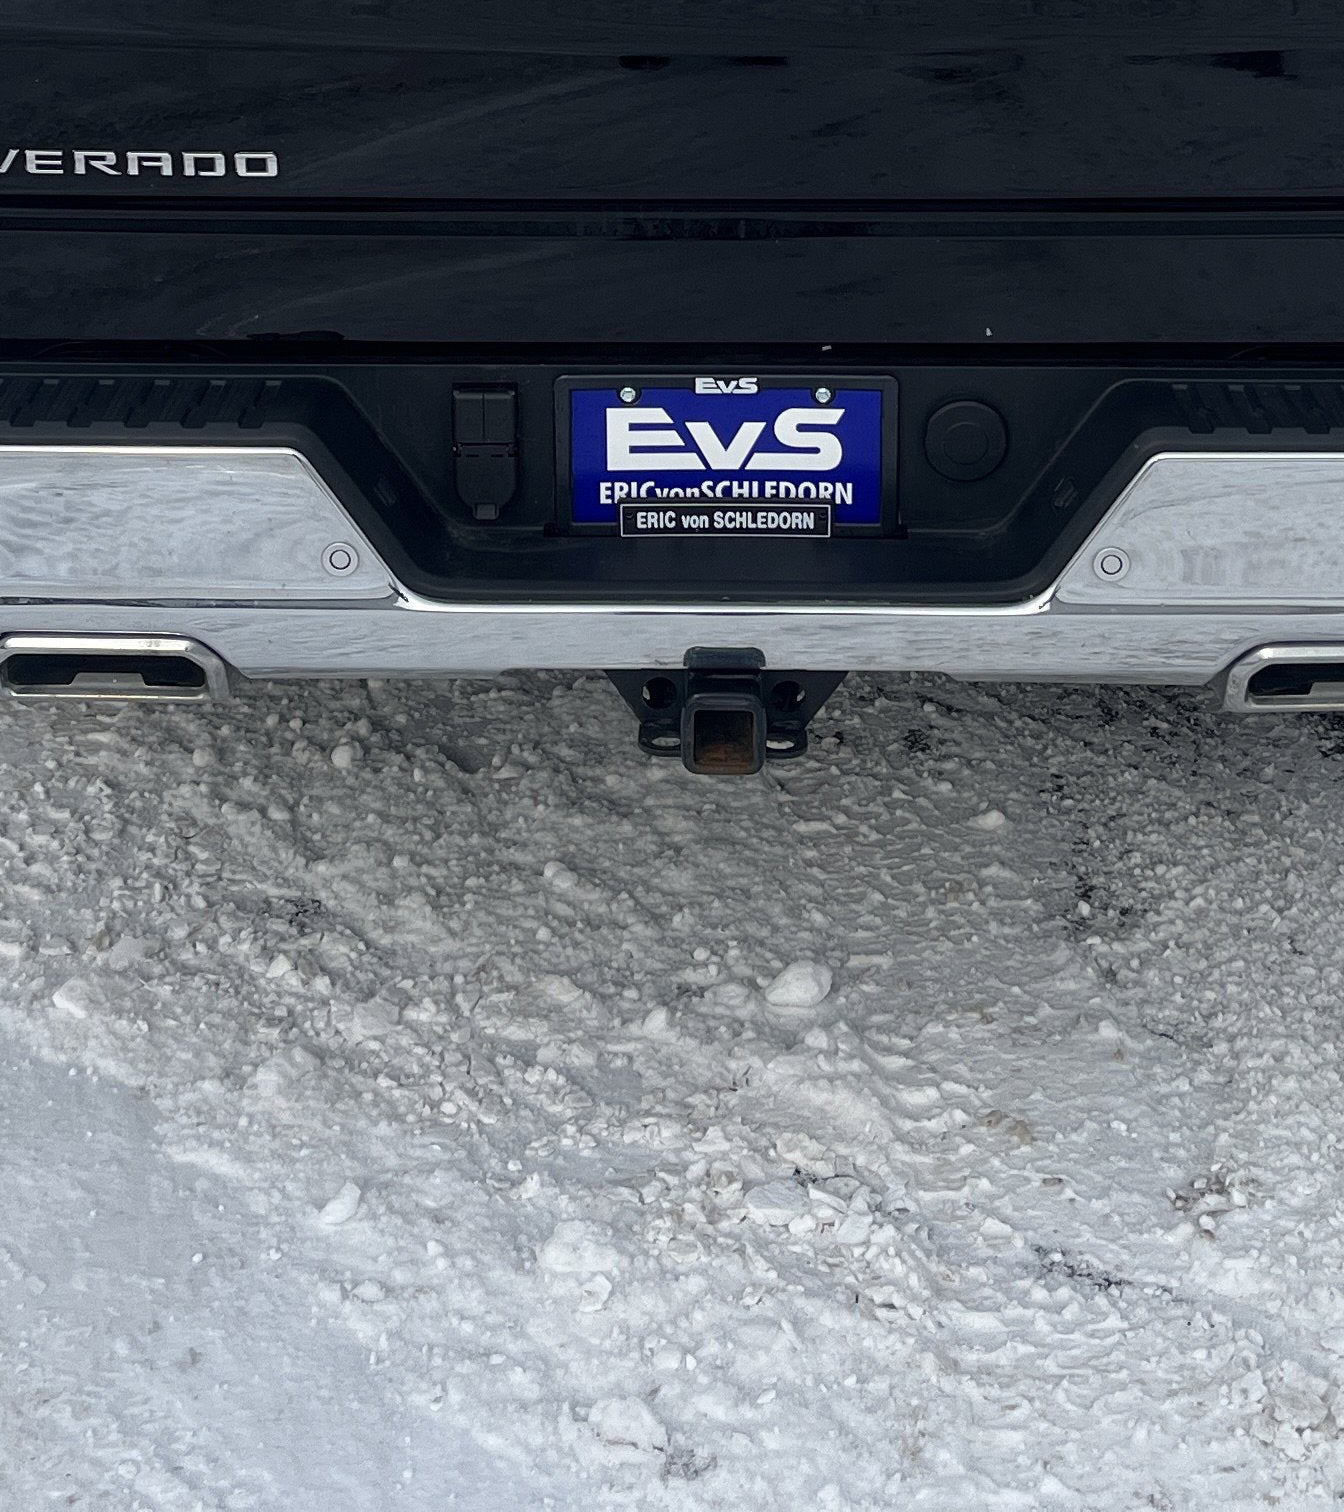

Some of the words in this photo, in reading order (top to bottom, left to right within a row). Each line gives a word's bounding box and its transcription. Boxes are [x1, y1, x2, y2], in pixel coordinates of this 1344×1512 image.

[636, 511, 676, 529] ERIC
[681, 514, 709, 529] von
[713, 511, 815, 530] SCHLEDORN
